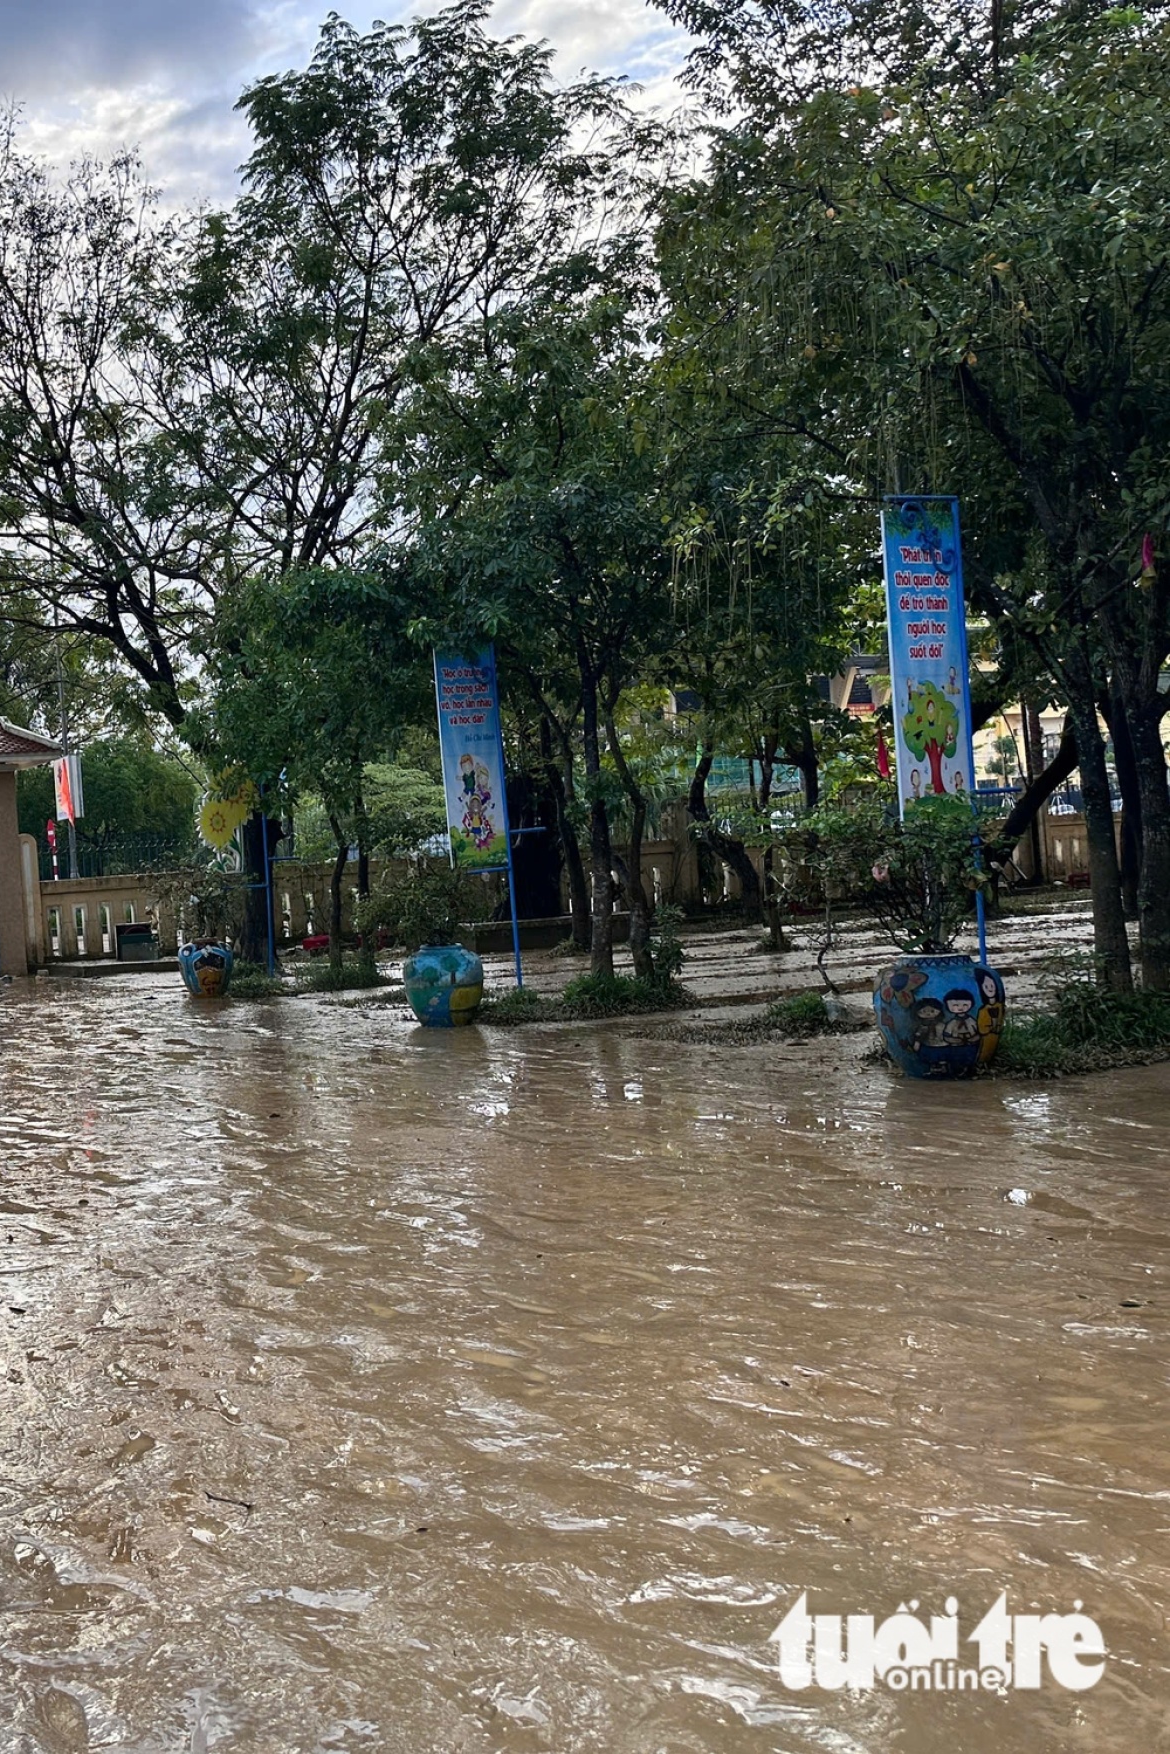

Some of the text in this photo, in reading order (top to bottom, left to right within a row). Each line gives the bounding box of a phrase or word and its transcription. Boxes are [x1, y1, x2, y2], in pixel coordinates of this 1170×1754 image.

[913, 574, 932, 591] quen
[926, 595, 949, 611] thành
[931, 619, 946, 638] học
[909, 641, 927, 659] suốt
[455, 683, 474, 696] trong
